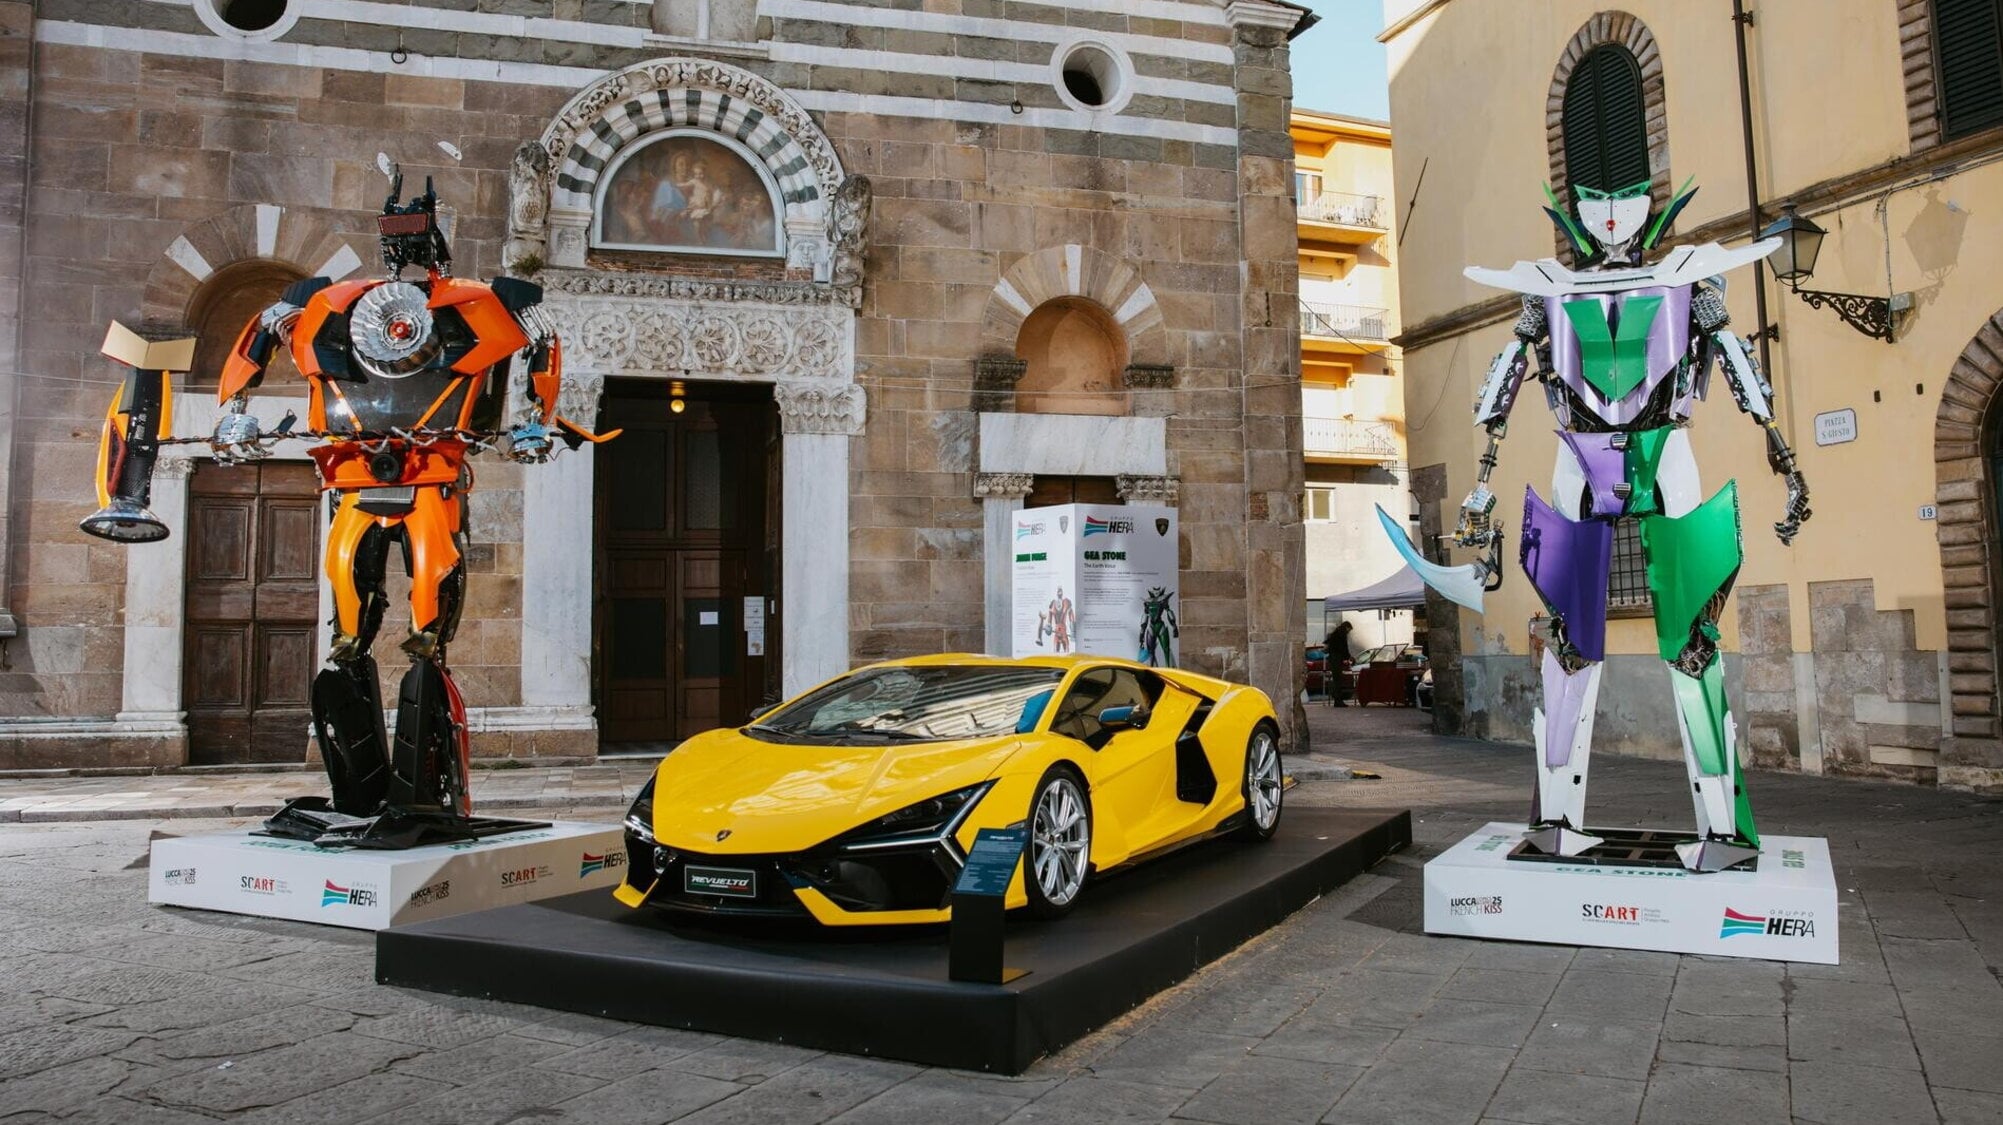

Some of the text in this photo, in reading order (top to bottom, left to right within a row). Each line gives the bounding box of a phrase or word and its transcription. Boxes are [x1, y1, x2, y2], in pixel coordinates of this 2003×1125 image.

[1824, 416, 1846, 427] PIAZZA
[1922, 508, 1933, 518] 19
[1108, 520, 1135, 534] HERA
[1084, 551, 1126, 561] GEA STONE
[603, 851, 627, 869] HERA
[501, 867, 536, 885] SCART
[691, 874, 749, 887] REVUELTO
[241, 876, 275, 891] SCART
[348, 889, 378, 907] HERA
[1451, 897, 1477, 907] LUCCA
[1492, 896, 1502, 905] 25
[1484, 904, 1503, 915] KISS
[1582, 904, 1640, 921] SCART
[1769, 908, 1814, 918] GRUPPO
[1766, 917, 1815, 938] HERA
